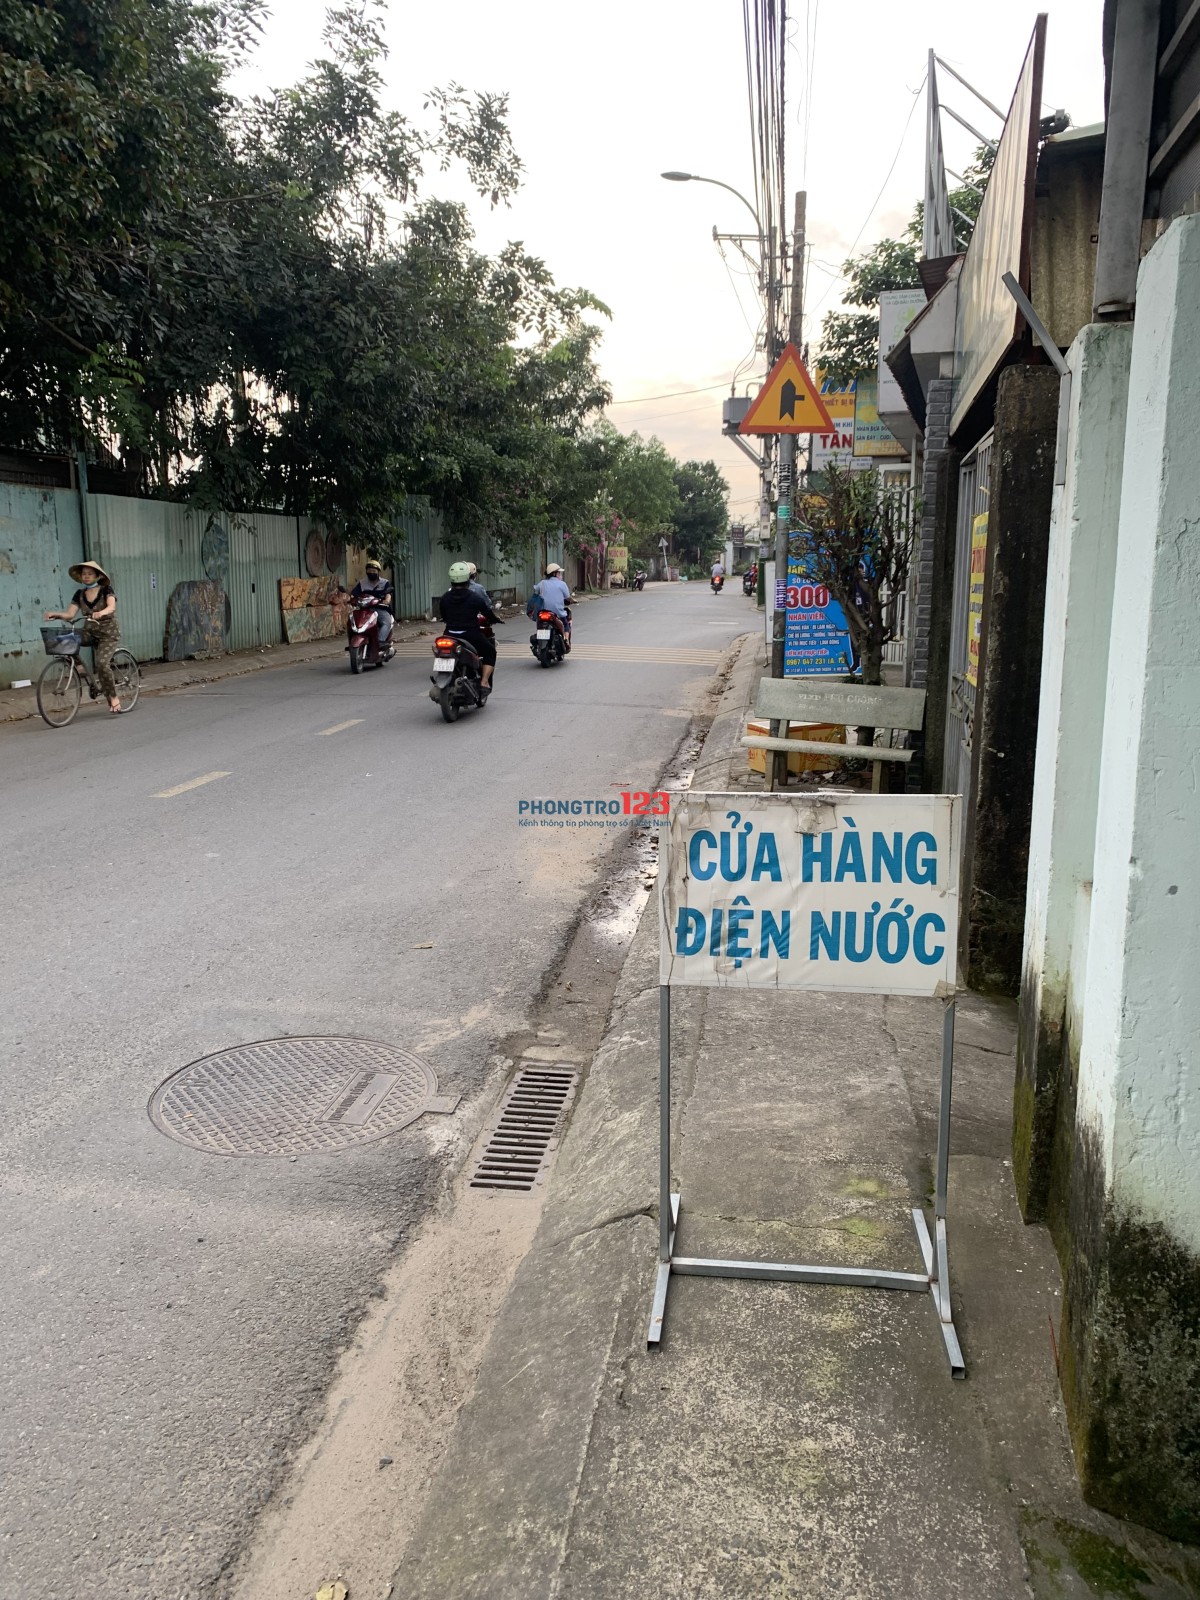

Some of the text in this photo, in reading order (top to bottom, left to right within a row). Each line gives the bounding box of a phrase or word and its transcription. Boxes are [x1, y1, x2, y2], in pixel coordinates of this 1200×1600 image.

[820, 430, 853, 449] TÂN
[786, 585, 830, 609] 300
[689, 811, 938, 886] CỬA HÀNG
[675, 895, 946, 969] ĐIỆN NƯỚC
